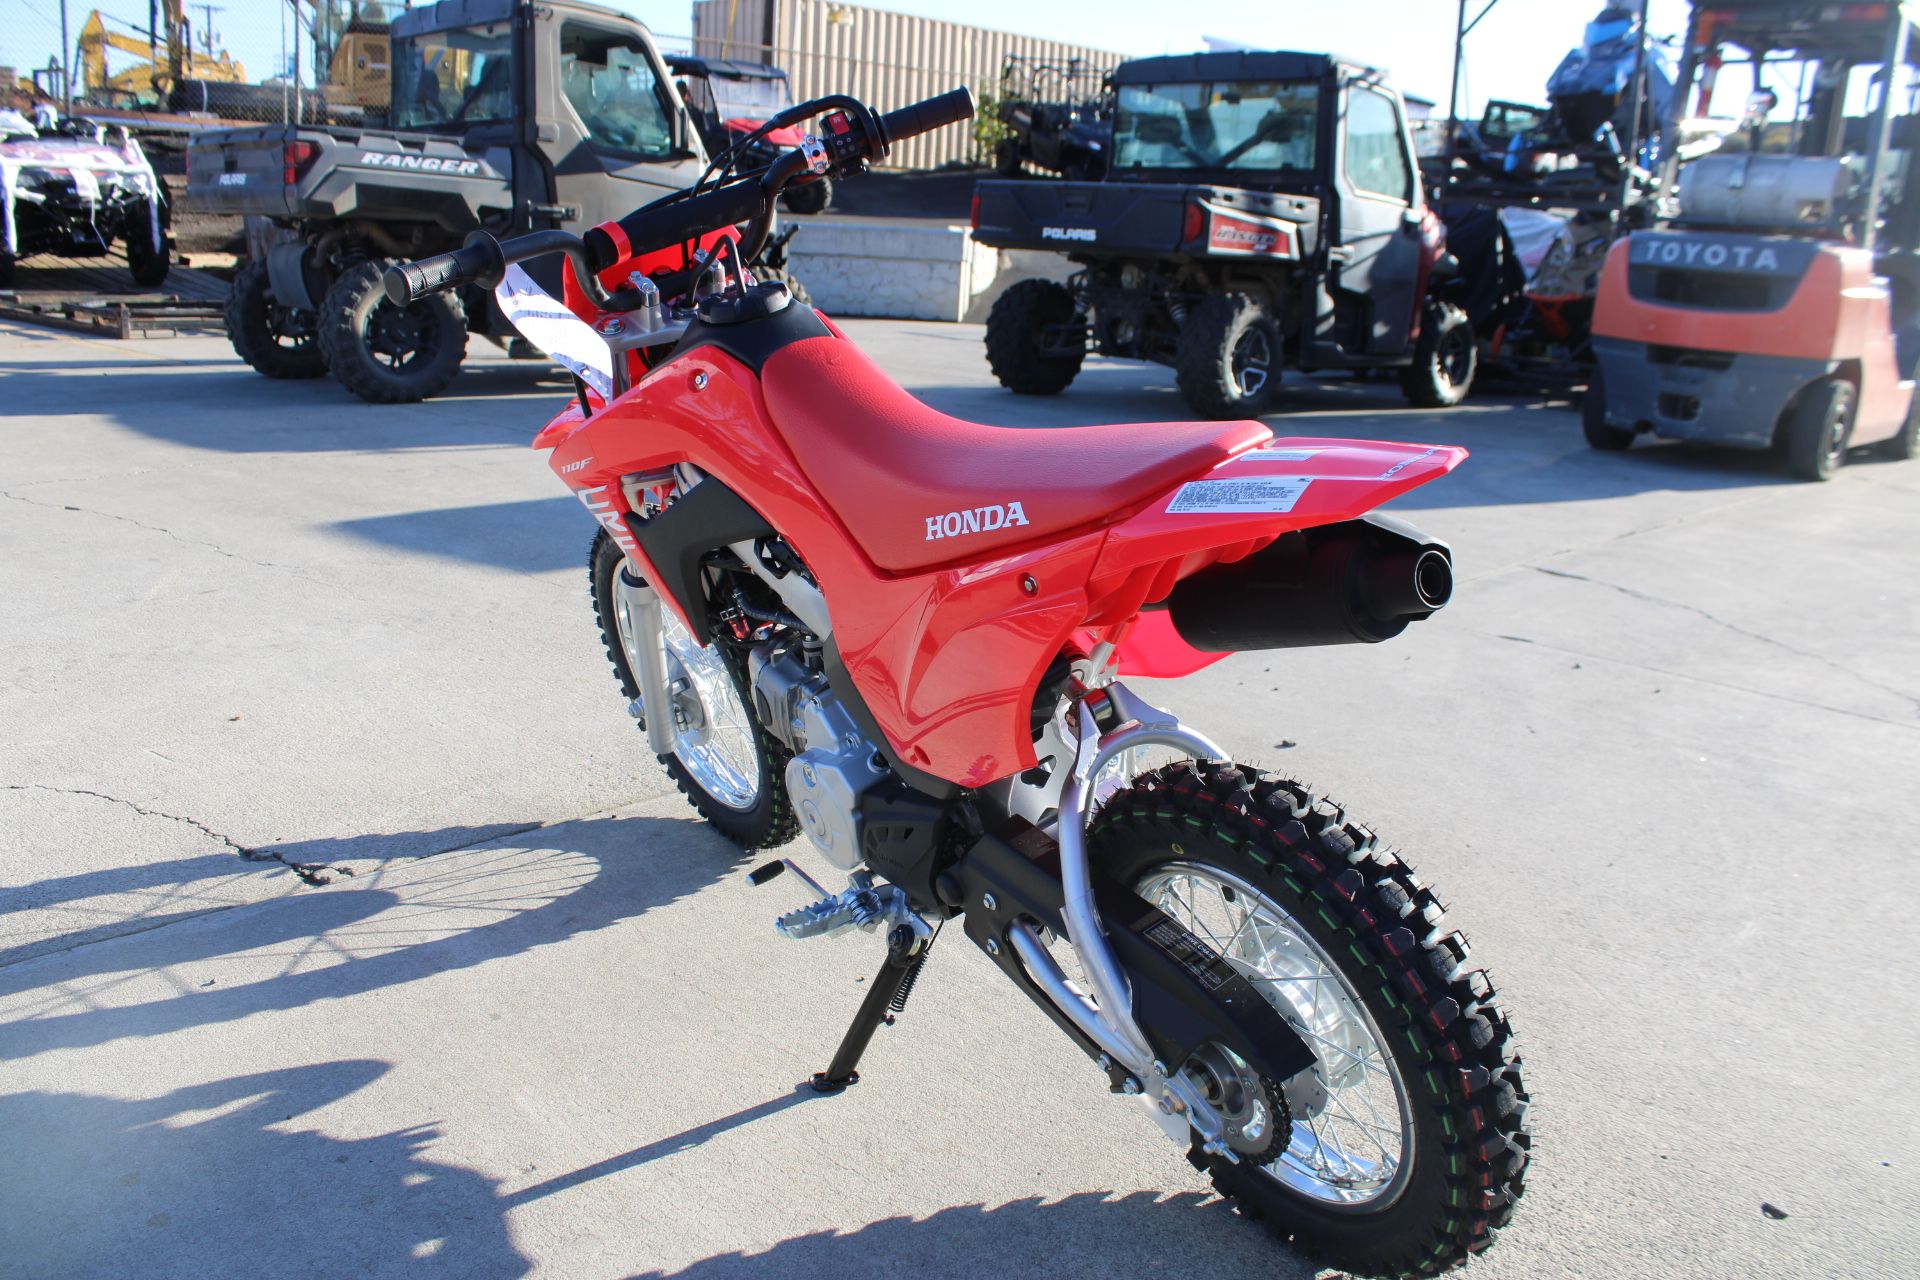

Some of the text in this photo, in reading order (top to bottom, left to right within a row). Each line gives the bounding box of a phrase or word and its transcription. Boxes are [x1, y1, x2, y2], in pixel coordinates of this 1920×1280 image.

[360, 151, 479, 176] RANGER
[1042, 227, 1096, 241] POLARIS
[1646, 240, 1778, 270] TOYOTA
[561, 457, 594, 474] 110F
[925, 501, 1030, 541] HONDA
[1181, 932, 1216, 959] DRIVE CHAIN
